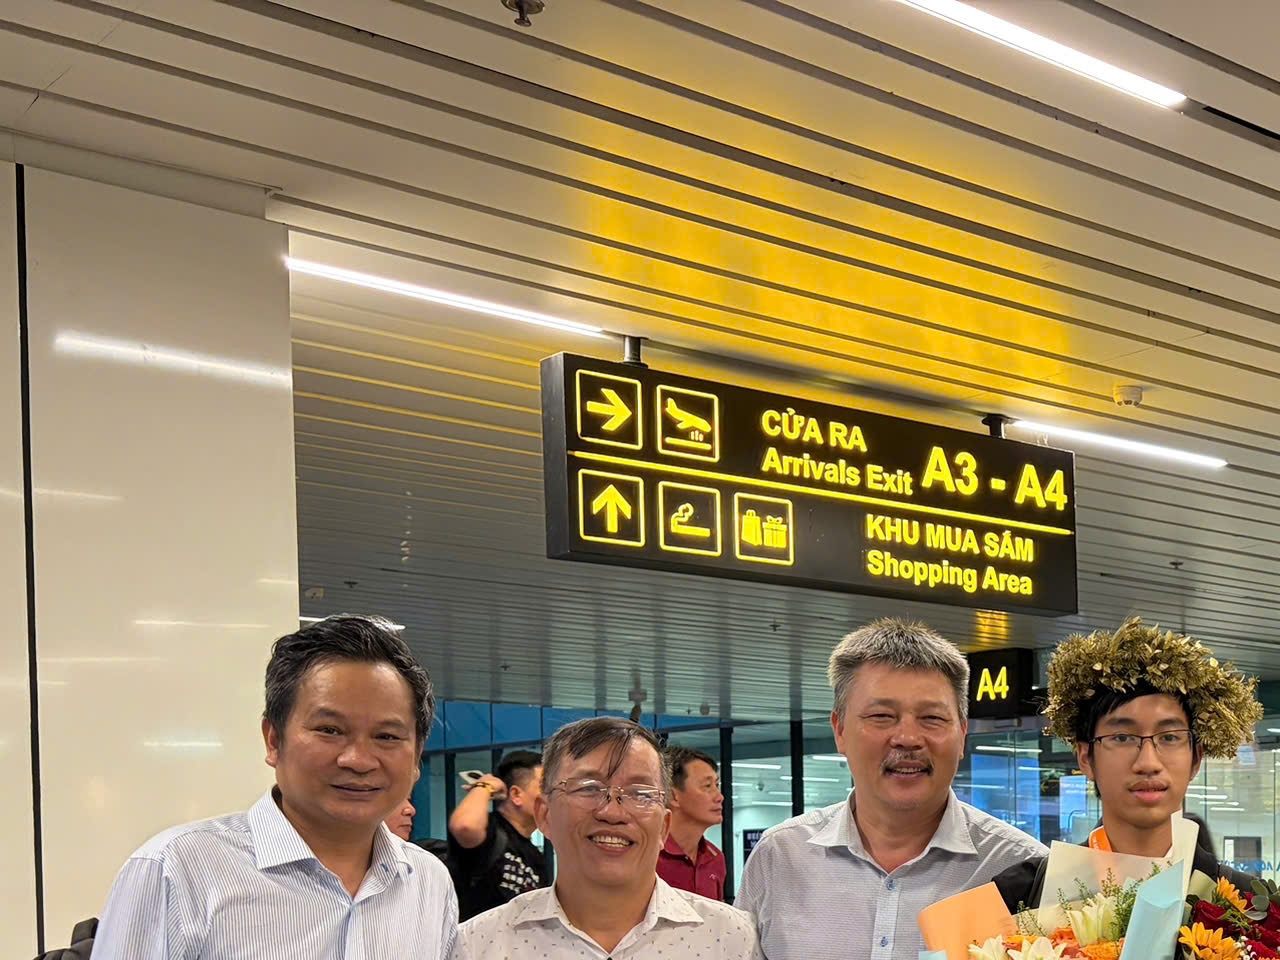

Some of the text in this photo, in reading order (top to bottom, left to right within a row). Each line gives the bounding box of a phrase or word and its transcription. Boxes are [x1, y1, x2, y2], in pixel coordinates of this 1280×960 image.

[762, 408, 868, 452] CỬA RA
[761, 447, 913, 495] Arrivals Exit
[921, 446, 978, 495] A3
[1015, 463, 1068, 511] A4
[866, 514, 920, 545] KHU
[926, 523, 980, 555] MUA
[867, 550, 1033, 595] Shopping Area
[976, 666, 1009, 701] A4
